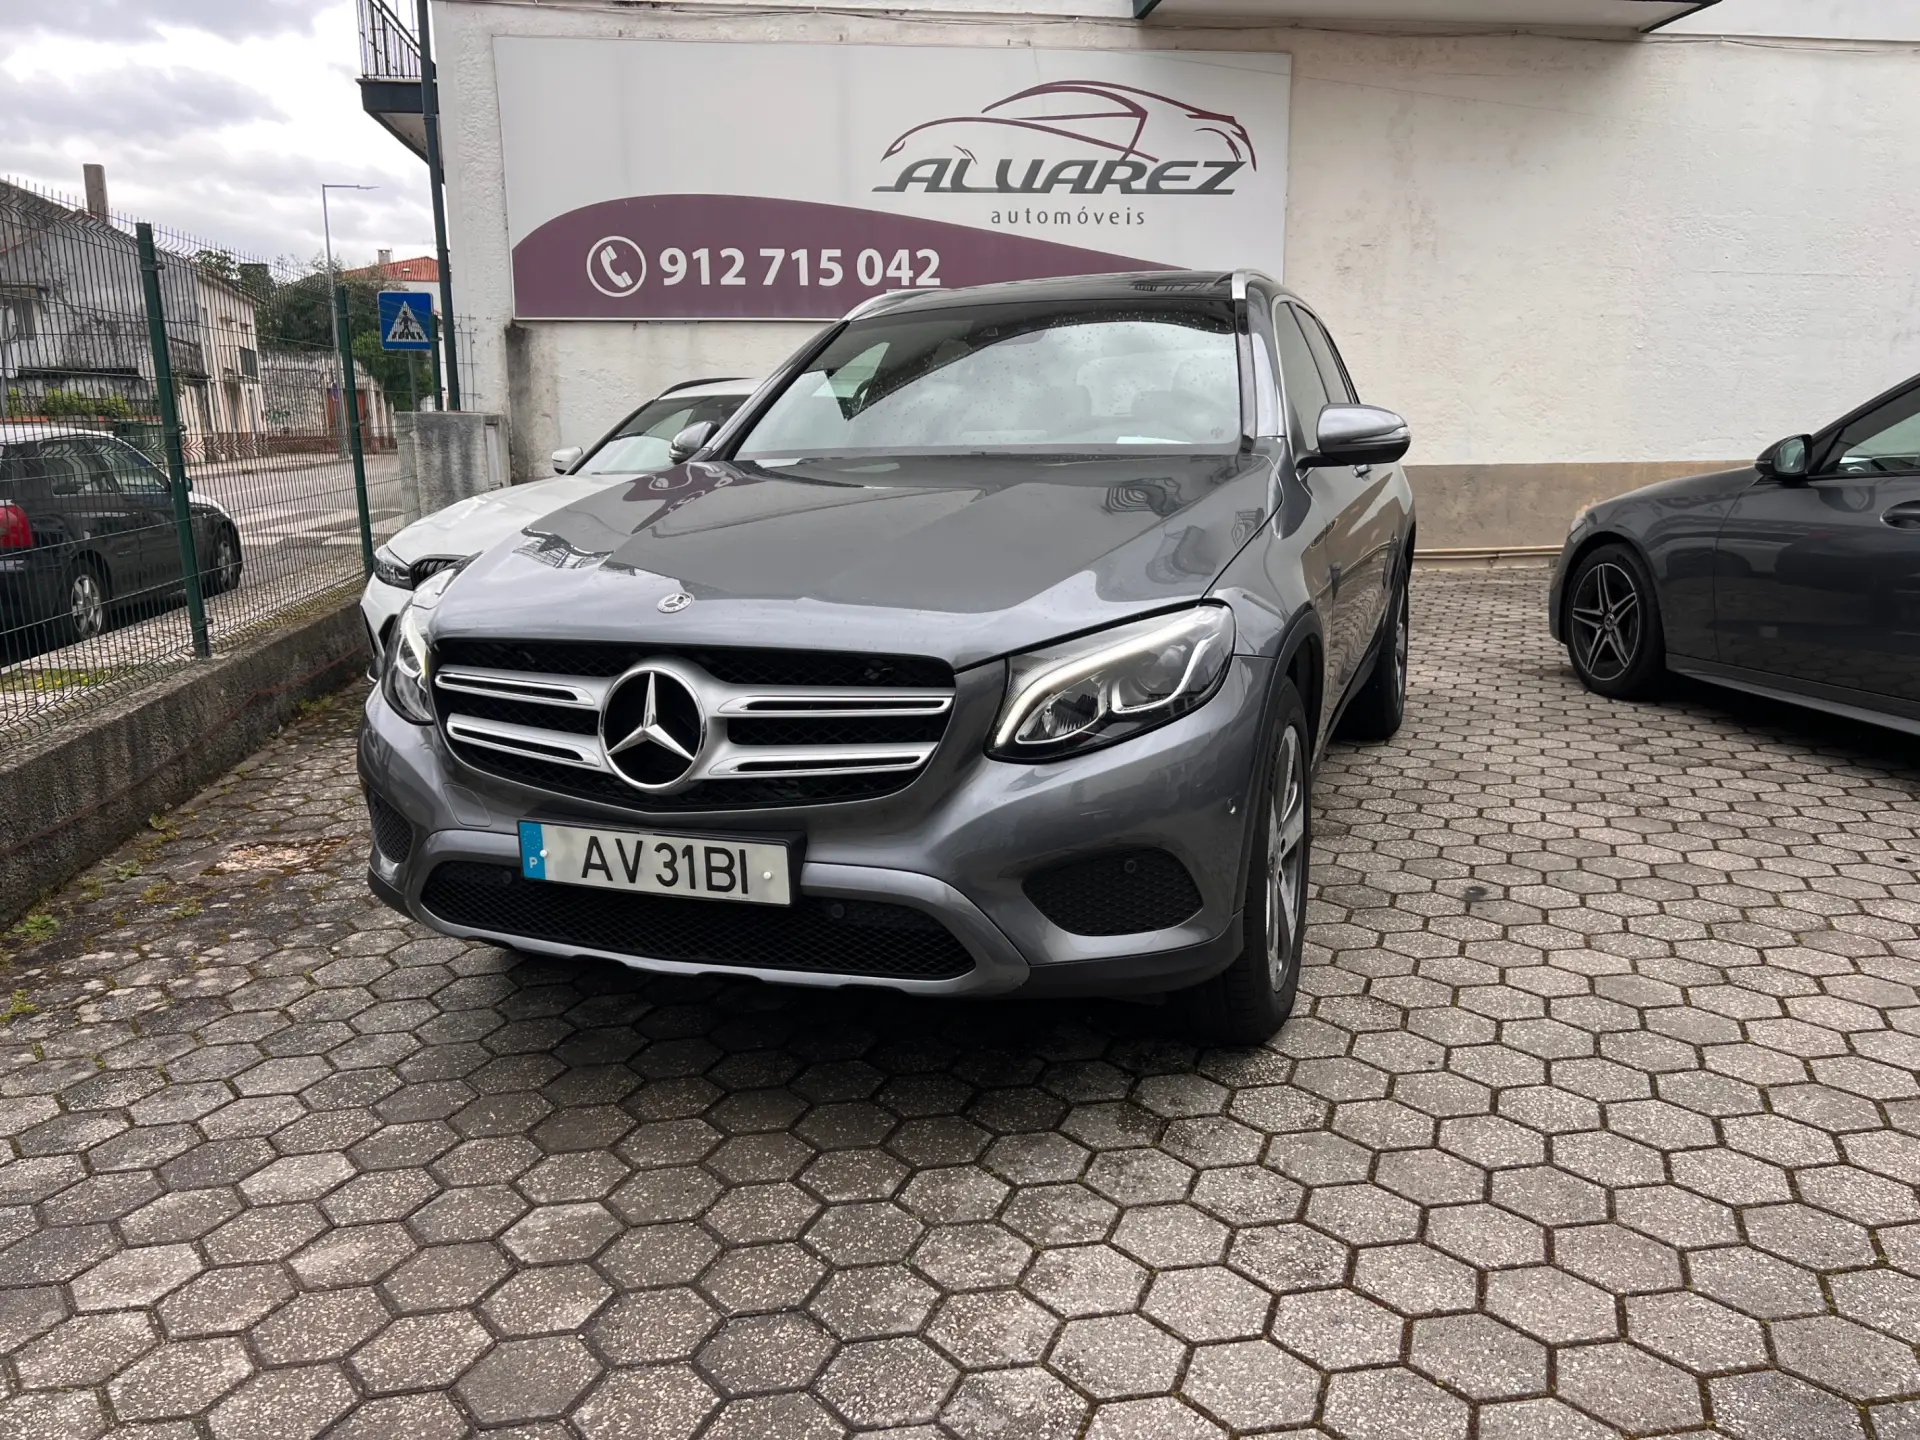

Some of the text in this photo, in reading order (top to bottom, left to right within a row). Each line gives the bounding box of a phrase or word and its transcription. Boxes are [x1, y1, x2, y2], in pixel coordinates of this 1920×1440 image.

[991, 206, 1145, 225] automóveis
[659, 247, 941, 287] 912 715 042
[529, 856, 538, 869] P
